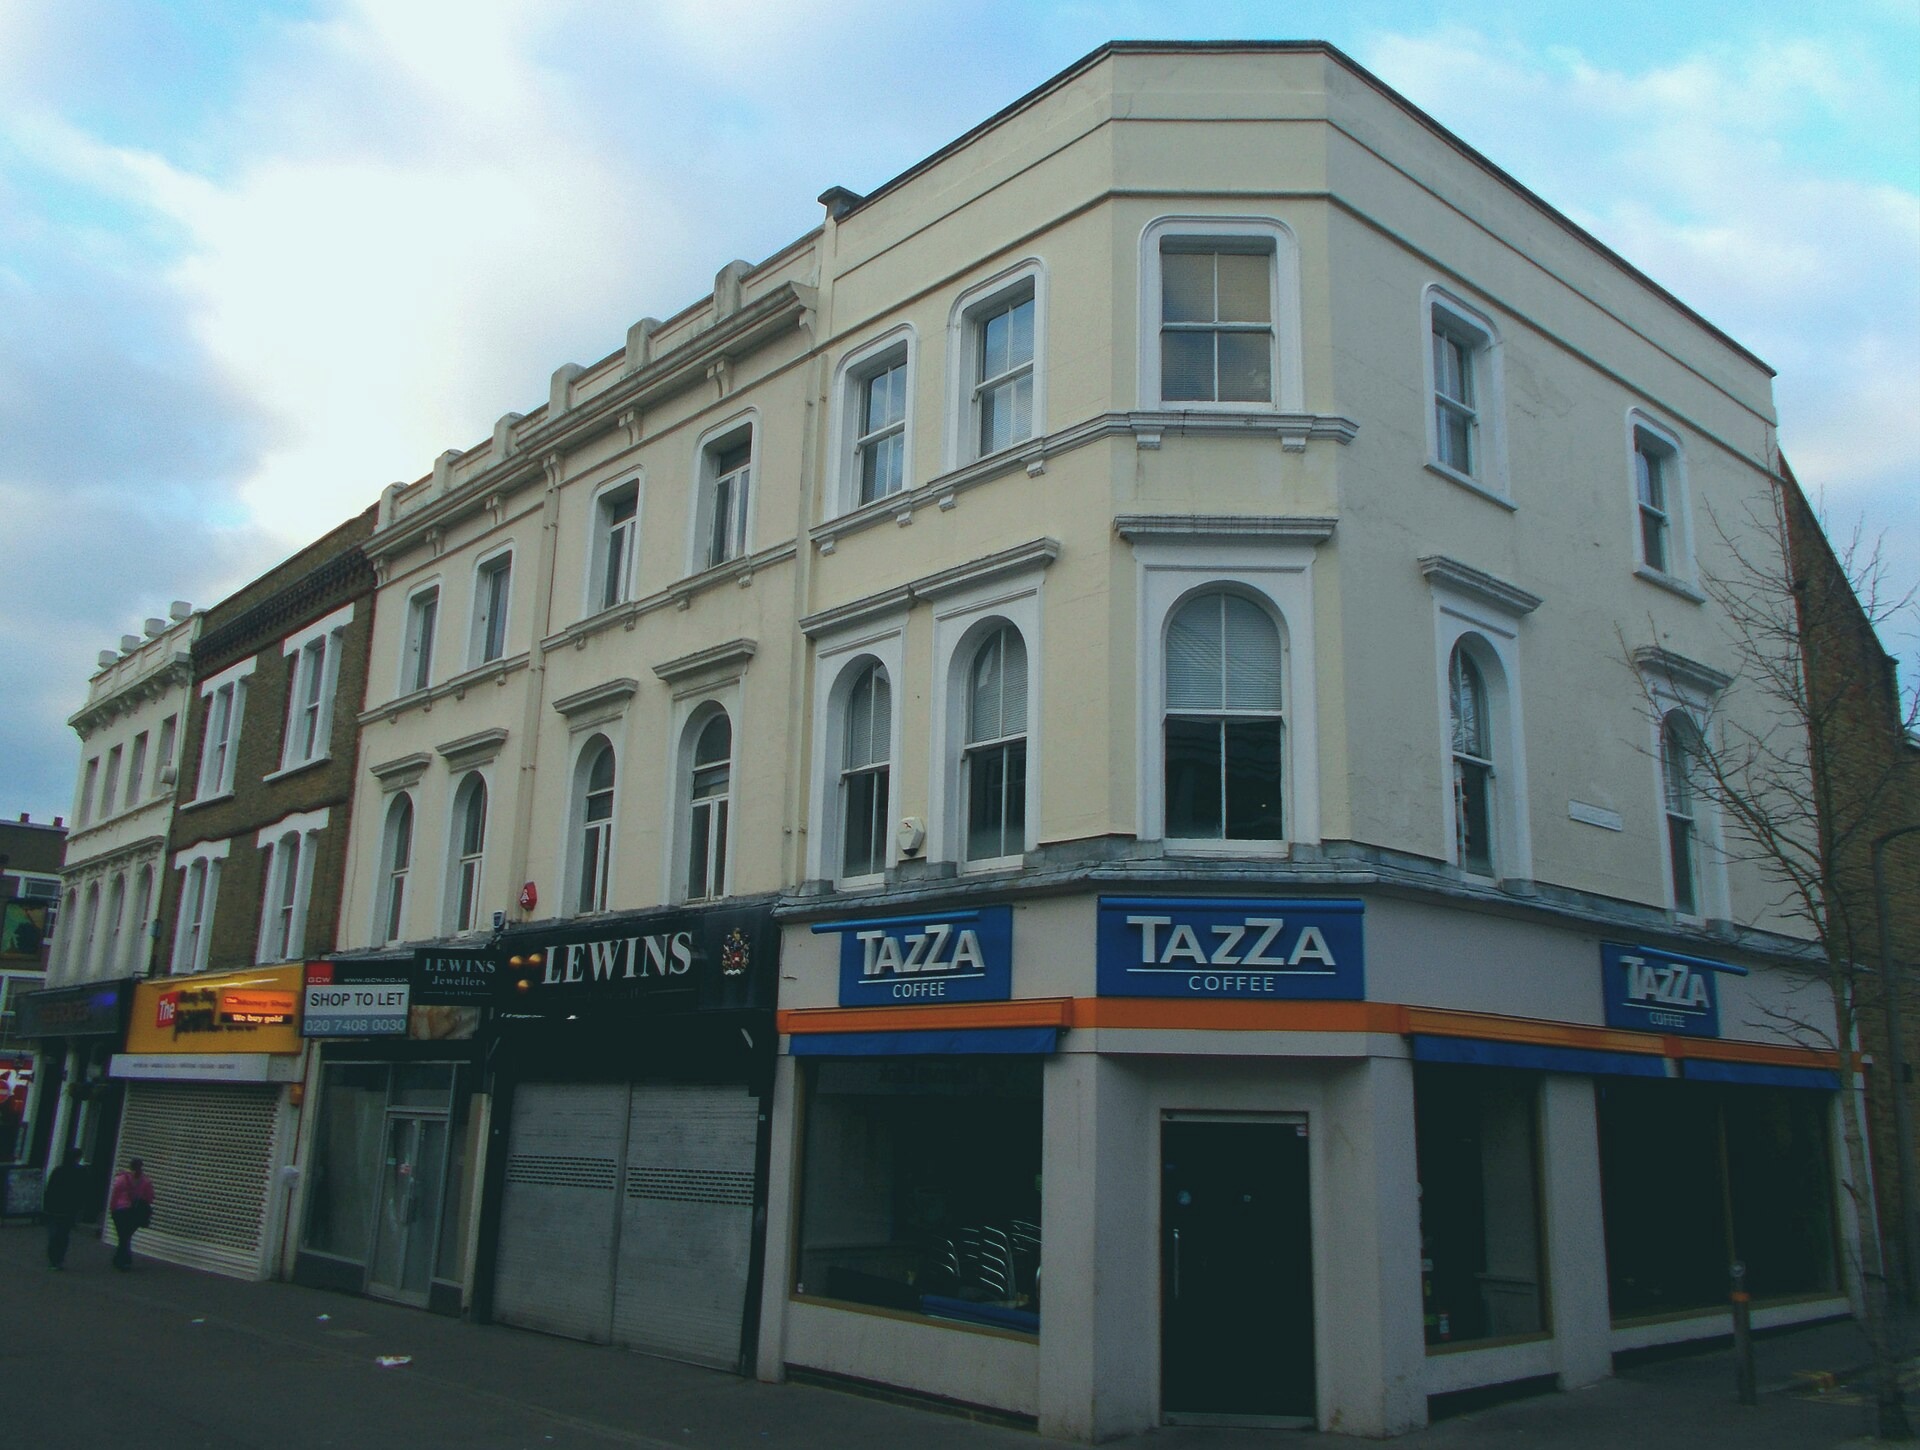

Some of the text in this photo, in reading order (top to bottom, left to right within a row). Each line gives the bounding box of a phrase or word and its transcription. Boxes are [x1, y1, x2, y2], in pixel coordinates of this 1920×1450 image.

[1126, 915, 1336, 965] TAZZA
[856, 923, 985, 975] TAZZA
[425, 958, 496, 973] LEWINS
[541, 931, 693, 985] LEWINS
[432, 975, 486, 986] Jewellers
[1188, 975, 1275, 991] COFFEE
[1619, 955, 1711, 1008] TAZZA
[893, 982, 946, 998] COFFEE
[310, 992, 405, 1007] SHOP TO LET
[159, 998, 176, 1022] The
[232, 1014, 284, 1024] We buy gold
[305, 1019, 407, 1032] 020 7408 0030
[1649, 1011, 1687, 1028] COFFEE
